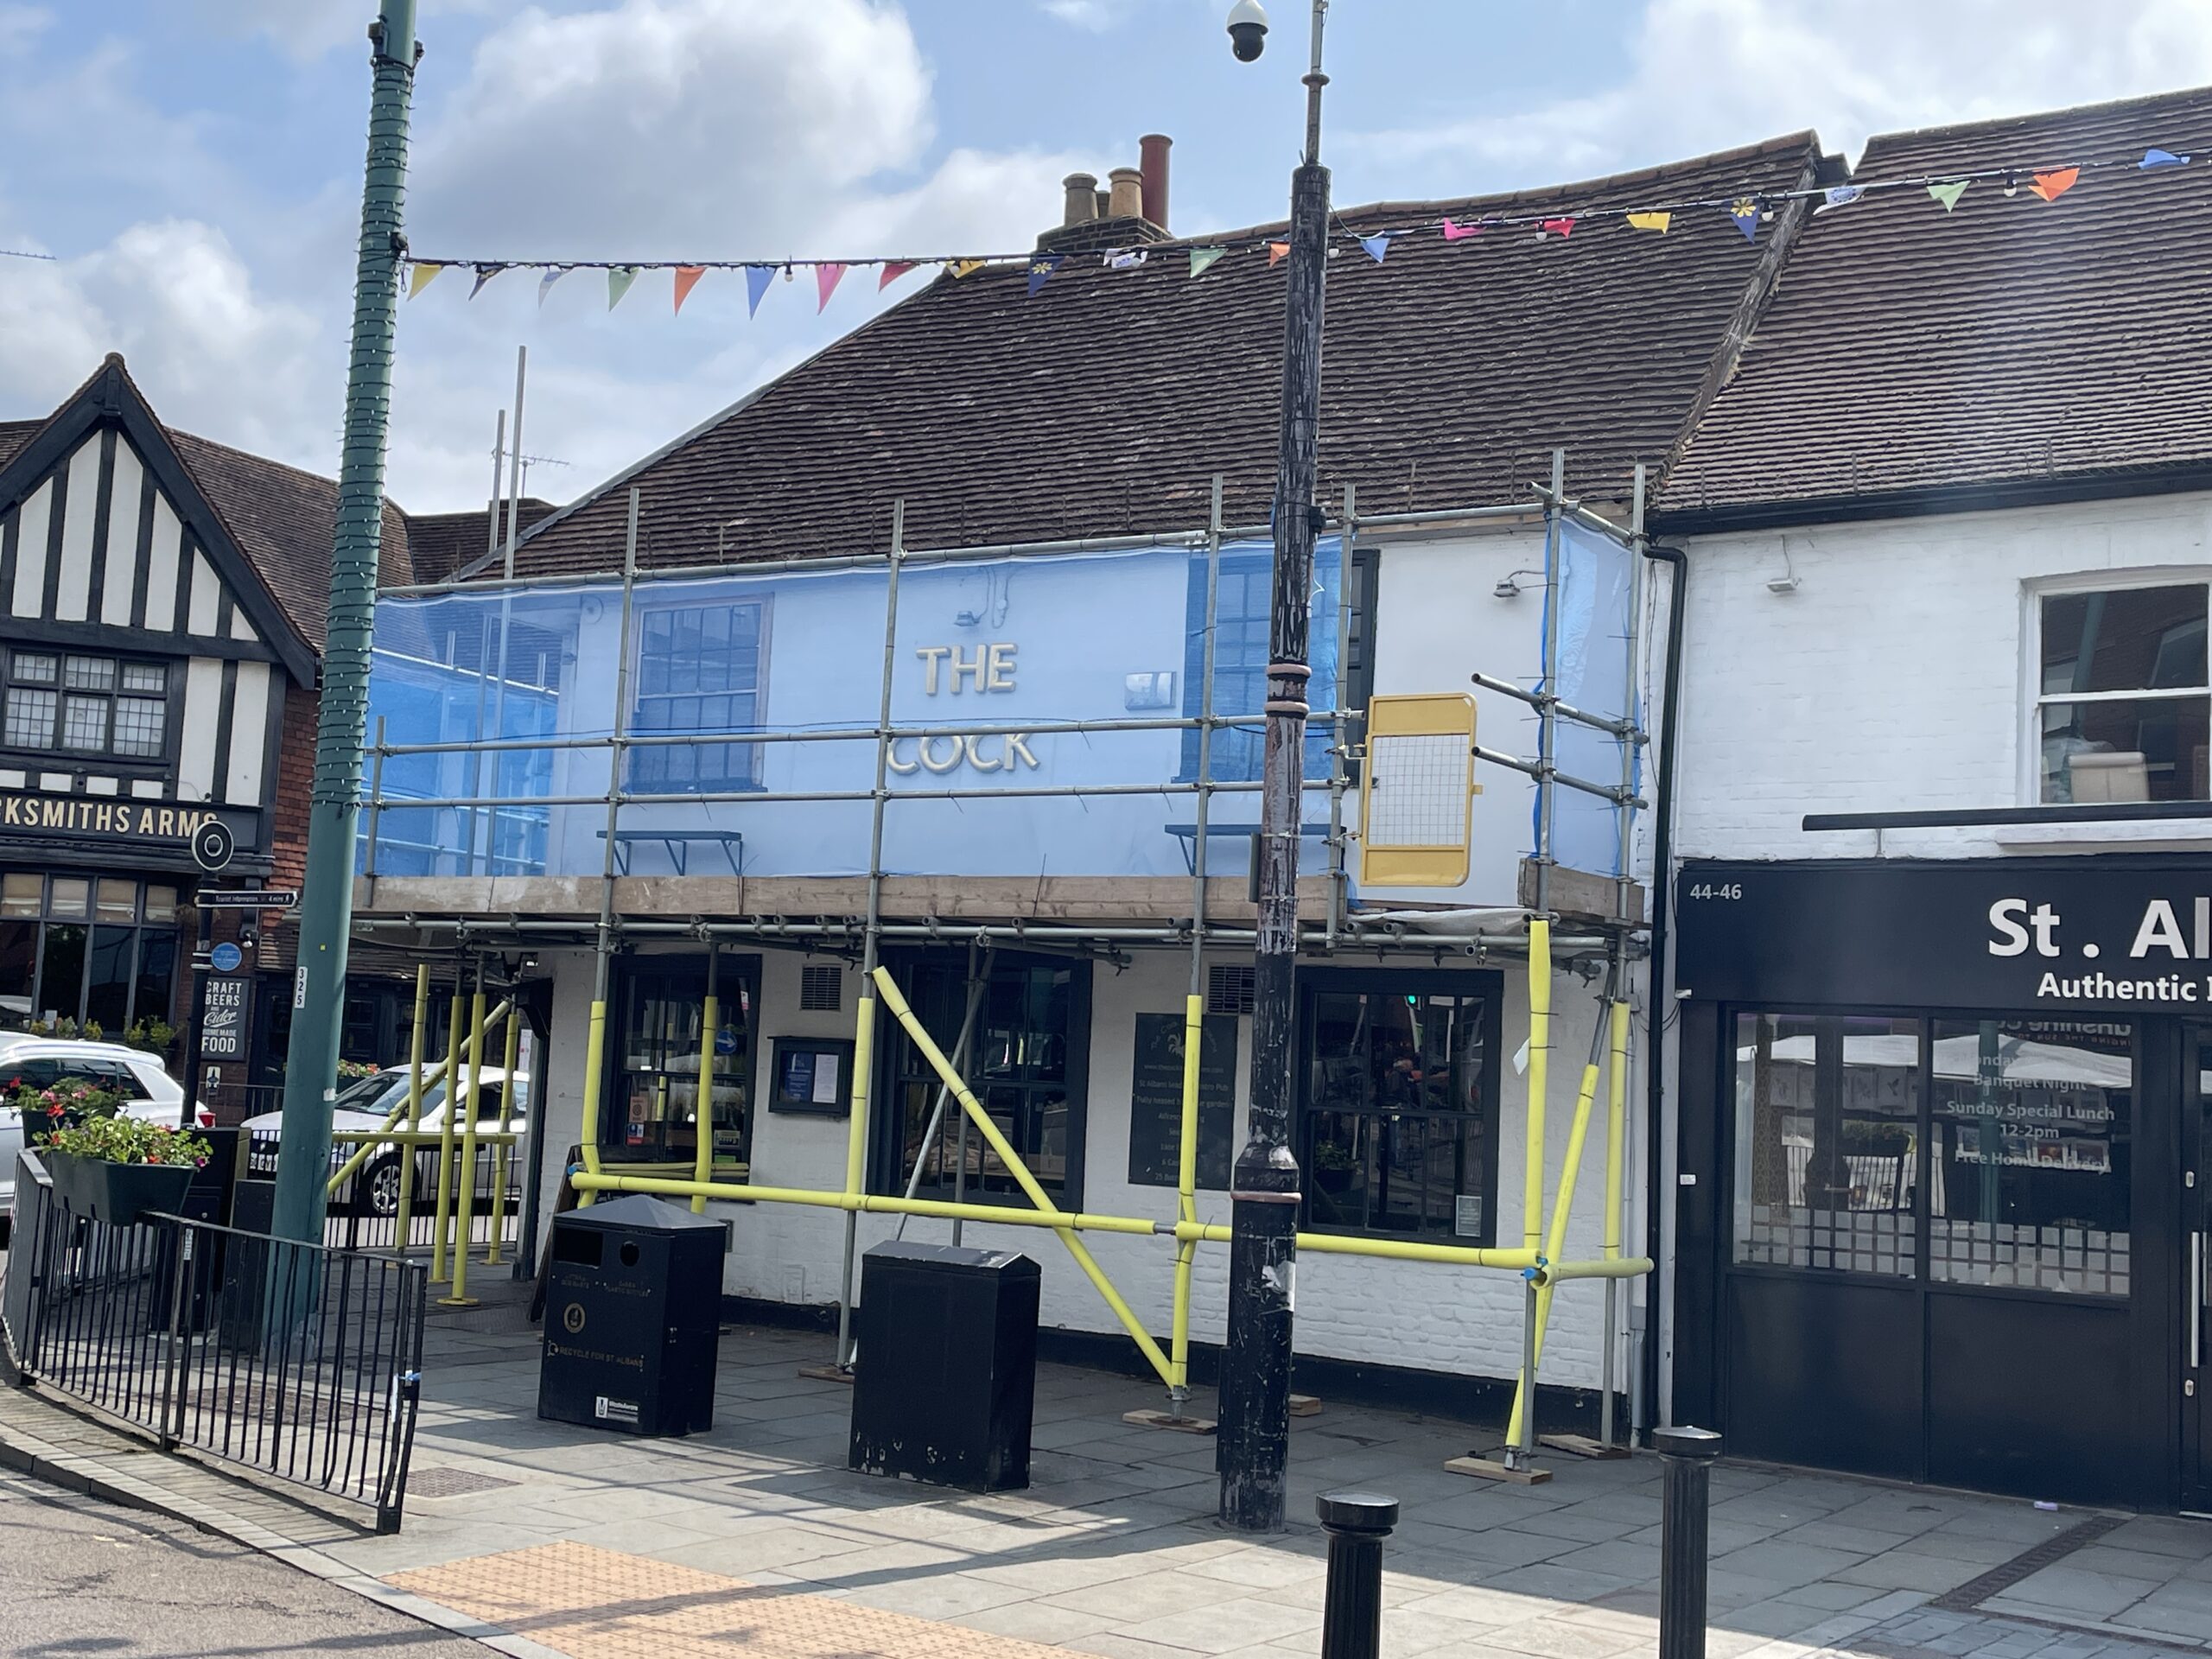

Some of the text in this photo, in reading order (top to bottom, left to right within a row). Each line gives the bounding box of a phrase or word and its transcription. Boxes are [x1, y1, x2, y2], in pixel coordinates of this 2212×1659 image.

[916, 643, 1017, 696] THE
[887, 732, 1040, 774] COCK
[0, 797, 131, 833] KSMITHS
[1689, 883, 1742, 900] 44-46
[1989, 898, 2060, 957] St
[2129, 897, 2210, 959] Al
[207, 981, 242, 994] CRAFT
[2037, 972, 2197, 1001] Authentic
[205, 994, 240, 1006] BEERS
[203, 1008, 238, 1028] Cider
[201, 1037, 236, 1053] FOOD
[1974, 1073, 2088, 1093] Banquet Night
[1947, 1100, 2116, 1121] Sunday Special Lunch
[2000, 1123, 2060, 1141] 12-2pm
[1955, 1149, 1987, 1164] Free
